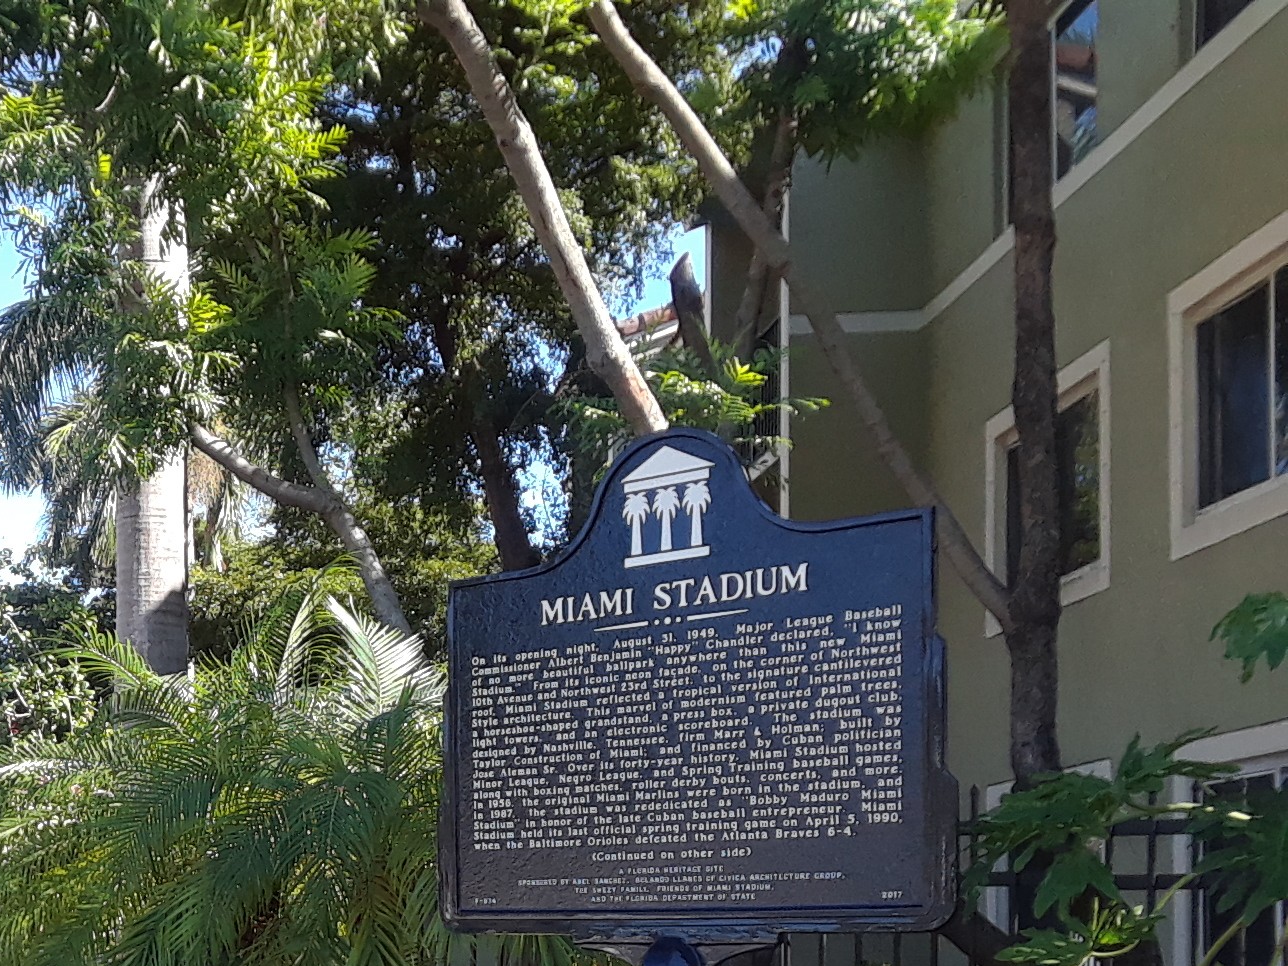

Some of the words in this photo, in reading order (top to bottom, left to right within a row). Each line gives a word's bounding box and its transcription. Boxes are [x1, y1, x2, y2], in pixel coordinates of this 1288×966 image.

[540, 587, 633, 625] MIAMI
[652, 562, 808, 609] STADIUM
[471, 661, 541, 676] Commissioner
[547, 654, 583, 668] Albert
[590, 648, 642, 662] Benjamin
[704, 634, 763, 650] Chandler
[866, 618, 901, 631] know
[471, 676, 482, 686] of
[488, 676, 500, 685] no
[508, 672, 534, 683] more
[542, 664, 594, 679] beautiful
[605, 657, 654, 672] ballpark
[666, 651, 726, 665] anywhere
[738, 646, 767, 657] than
[780, 640, 806, 653] this
[819, 637, 846, 648] new
[860, 629, 902, 644] Miami
[532, 680, 559, 690] From
[564, 677, 579, 687] its
[584, 672, 619, 685] iconic
[624, 670, 651, 680] neon
[712, 662, 727, 671] on
[732, 659, 753, 669] the
[759, 654, 804, 666] corner
[809, 649, 824, 661] of
[830, 641, 901, 659] Northwest
[472, 696, 493, 707] 10th
[496, 693, 533, 705] Avenue
[536, 689, 556, 700] and
[560, 683, 615, 697] Northwest
[620, 680, 647, 692] 23rd
[702, 674, 715, 683] to
[720, 671, 741, 681] the
[746, 664, 808, 680] signature
[813, 653, 902, 672] cantilevered
[505, 702, 537, 714] Miami
[543, 698, 588, 710] Stadium
[596, 691, 650, 705] reflected
[657, 691, 664, 699] a
[672, 683, 721, 698] tropical
[730, 679, 777, 692] version
[785, 676, 798, 686] of
[808, 665, 901, 685] International
[471, 716, 498, 728] Style
[585, 705, 610, 717] This
[616, 701, 656, 714] marvel
[661, 699, 673, 710] of
[680, 694, 746, 708] modernism
[754, 686, 811, 701] featured
[820, 683, 852, 697] palm
[472, 736, 496, 748] light
[555, 730, 575, 740] and
[583, 730, 597, 738] an
[606, 722, 667, 736] electronic
[772, 712, 797, 723] The
[809, 707, 861, 720] stadium
[875, 704, 902, 714] was
[472, 758, 506, 769] Taylor
[513, 752, 583, 765] Construction
[589, 749, 600, 760] of
[659, 743, 680, 754] and
[691, 738, 746, 752] financed
[756, 737, 771, 748] by
[781, 734, 823, 745] Cuban
[833, 728, 901, 744] politician
[473, 800, 484, 810] In
[521, 797, 539, 807] the
[544, 793, 590, 806] original
[596, 791, 630, 802] Miami
[634, 789, 679, 800] Marlins
[686, 788, 716, 797] were
[721, 785, 751, 795] born
[758, 783, 771, 793] in
[778, 782, 800, 792] the
[877, 775, 902, 786] and
[525, 818, 536, 828] in
[540, 818, 572, 827] honor
[576, 815, 588, 825] of
[593, 815, 612, 824] the
[618, 813, 641, 823] late
[646, 811, 684, 822] Cuban
[691, 807, 745, 820] baseball
[861, 800, 902, 811] Miami
[528, 807, 546, 817] the
[553, 804, 598, 816] stadium
[605, 804, 626, 812] was
[633, 798, 708, 811] rededicated
[718, 798, 731, 807] as
[799, 791, 849, 802] Maduro
[860, 787, 902, 799] Miami
[473, 830, 514, 840] Stadium
[520, 828, 542, 838] held
[548, 827, 562, 837] its
[567, 826, 588, 836] last
[593, 824, 636, 835] official
[642, 822, 679, 834] spring
[685, 820, 738, 832] training
[743, 819, 776, 831] game
[782, 818, 798, 826] on
[805, 814, 839, 828] April
[473, 841, 500, 850] when
[506, 840, 523, 849] the
[528, 838, 581, 848] Baltimore
[586, 835, 628, 846] Orioles
[634, 832, 687, 844] defeated
[694, 832, 714, 841] the
[720, 830, 768, 841] Atlanta
[775, 828, 819, 838] Braves
[591, 850, 654, 861] (Continued
[660, 851, 674, 859] on
[680, 848, 714, 858] other
[720, 846, 751, 857] side)
